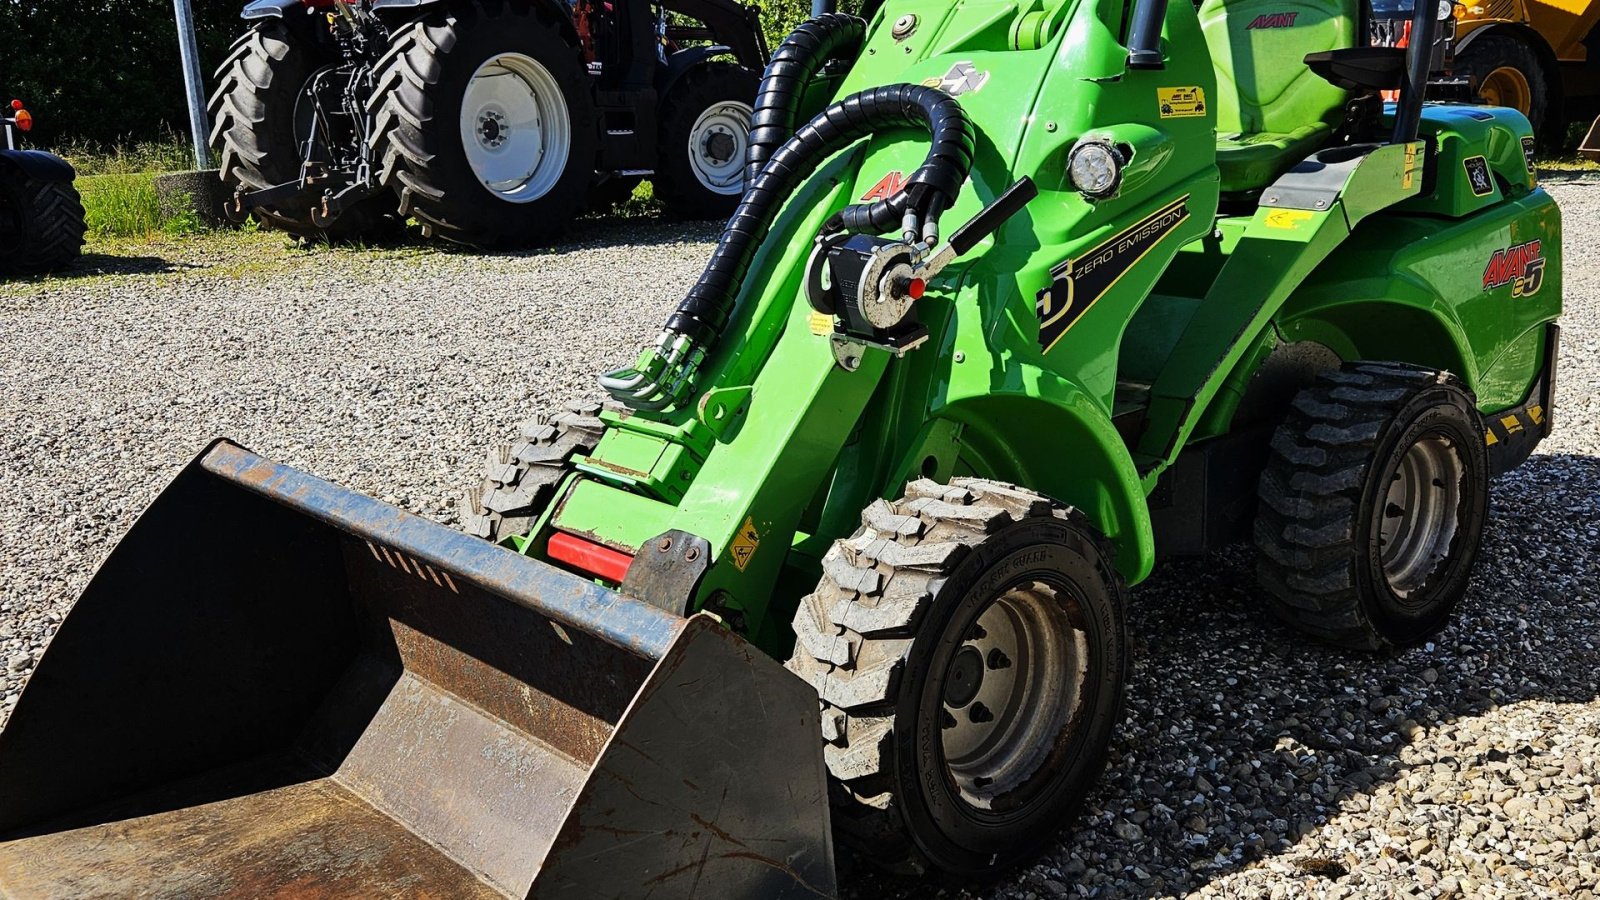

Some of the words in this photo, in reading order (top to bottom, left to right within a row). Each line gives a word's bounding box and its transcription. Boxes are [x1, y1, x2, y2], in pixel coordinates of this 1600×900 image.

[1245, 12, 1299, 30] AVANT
[1075, 250, 1114, 280] ZERO
[1118, 209, 1182, 254] EMISSION
[1483, 238, 1541, 291] AVANT
